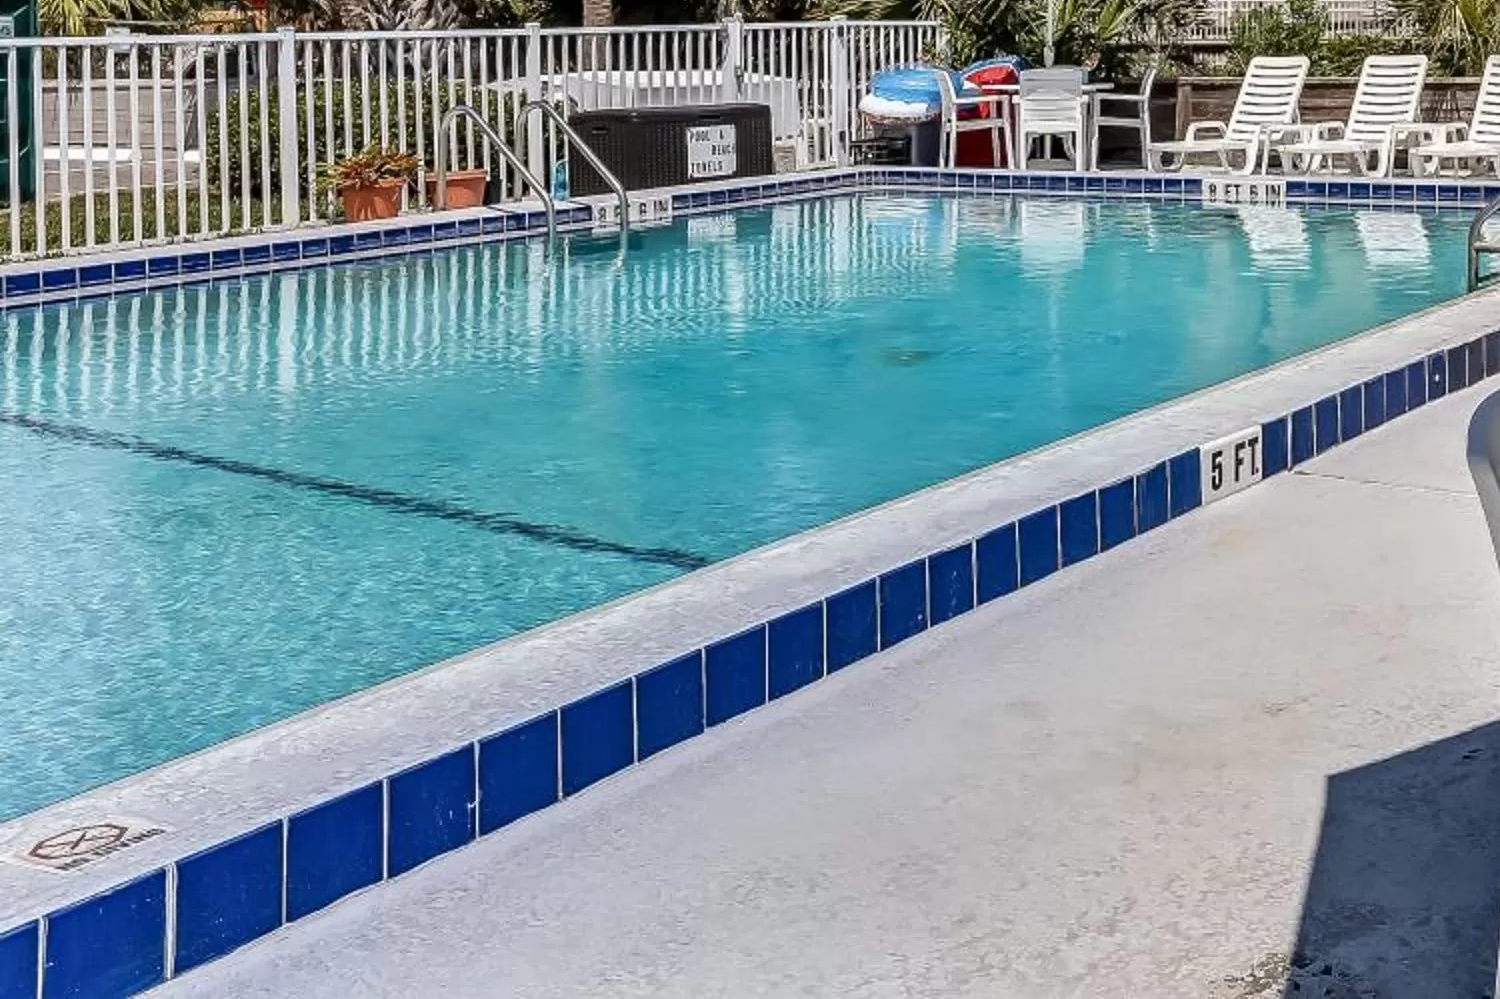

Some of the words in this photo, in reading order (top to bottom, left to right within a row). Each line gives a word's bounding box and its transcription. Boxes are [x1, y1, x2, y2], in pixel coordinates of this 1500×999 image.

[1265, 183, 1281, 207] IN
[1211, 450, 1223, 491] 5
[1234, 436, 1259, 483] FT.
